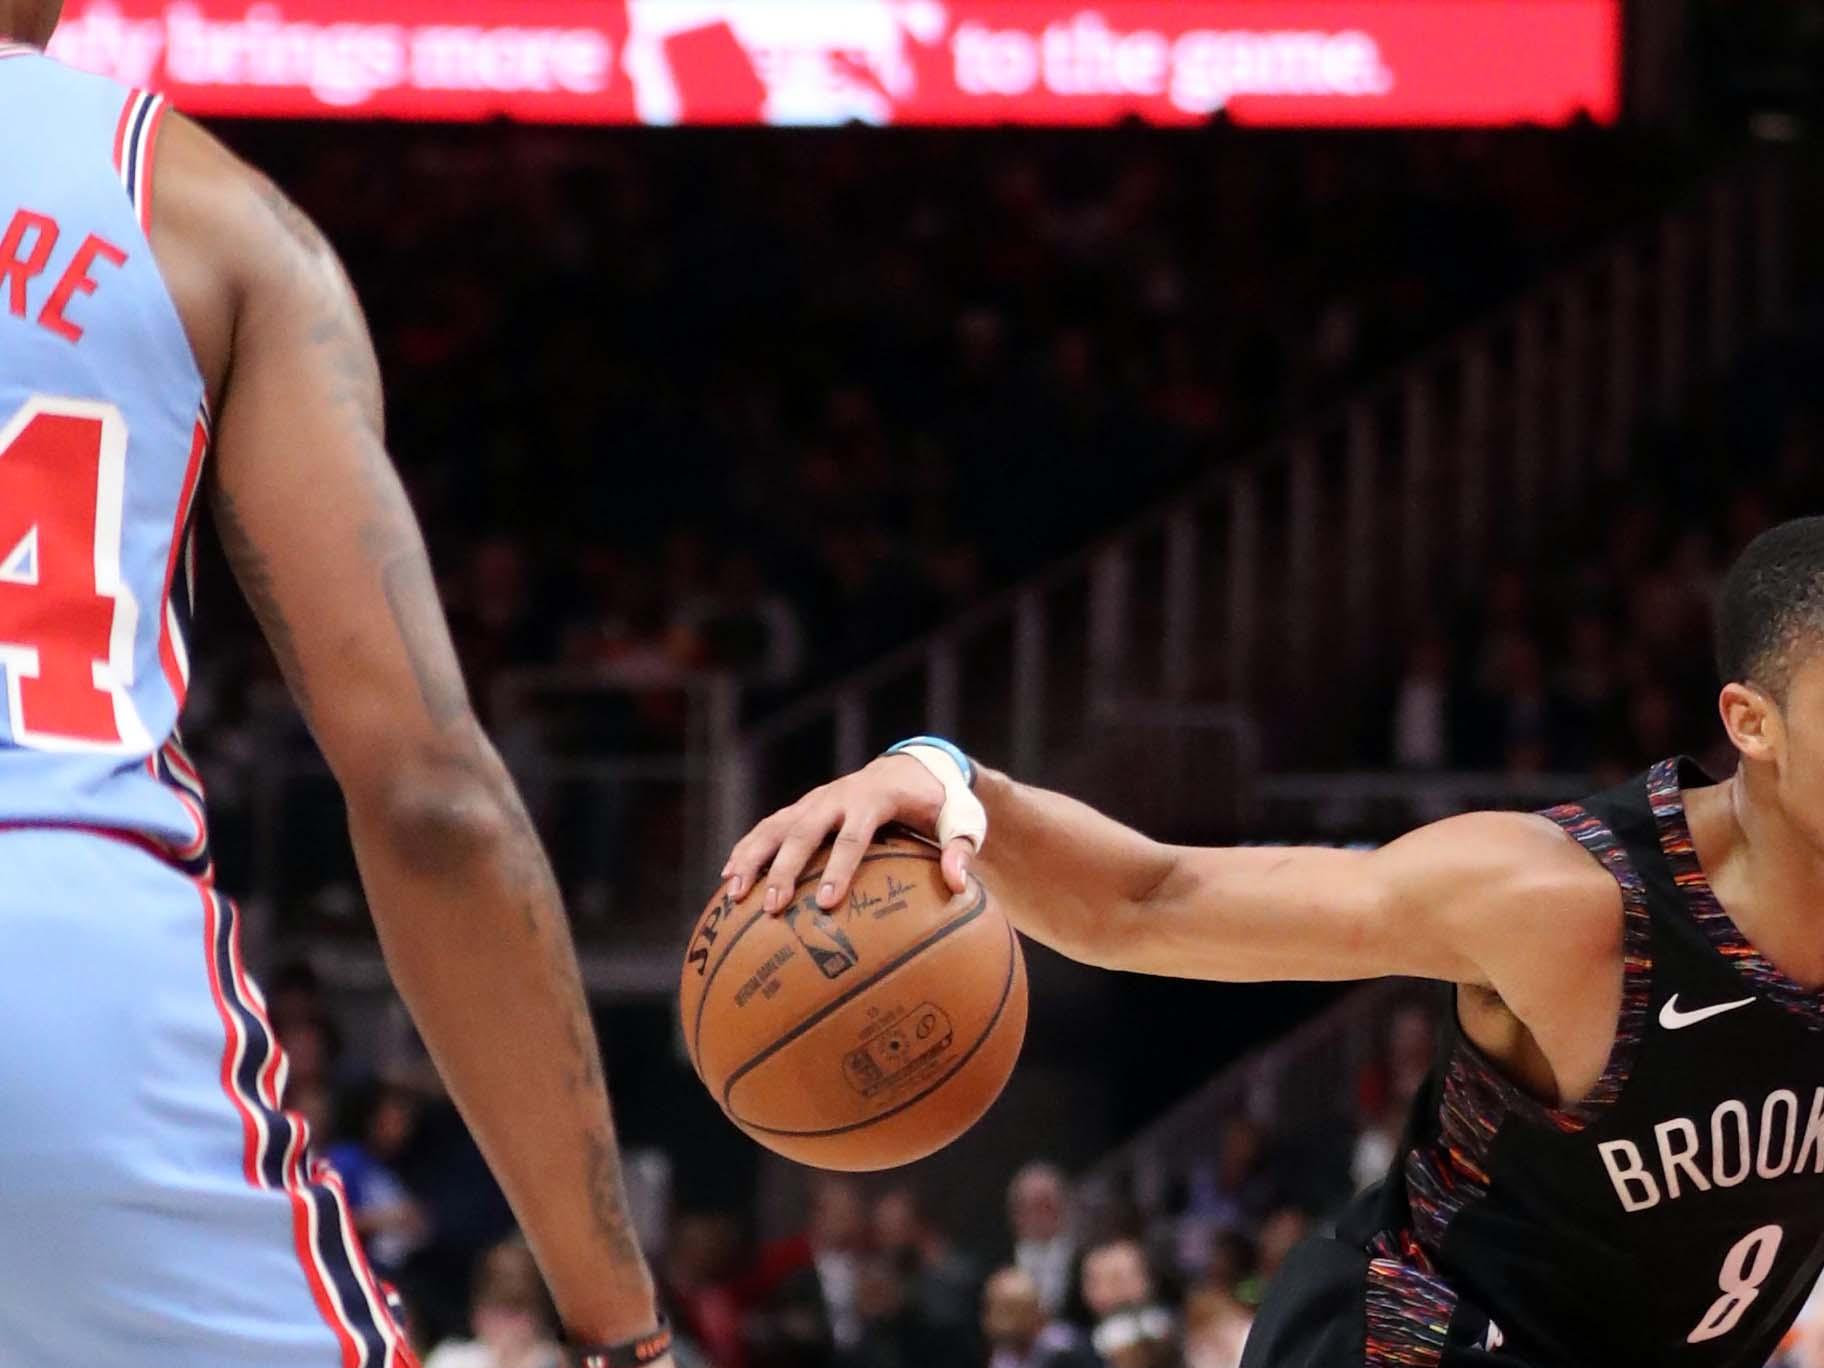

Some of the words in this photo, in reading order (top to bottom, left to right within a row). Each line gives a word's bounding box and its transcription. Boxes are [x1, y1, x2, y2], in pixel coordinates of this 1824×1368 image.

[167, 2, 404, 106] brings
[410, 25, 612, 93] more
[953, 21, 1039, 95] to
[1042, 11, 1168, 96] the
[0, 208, 128, 345] RE
[0, 394, 154, 757] 4
[1686, 1224, 1784, 1344] 8
